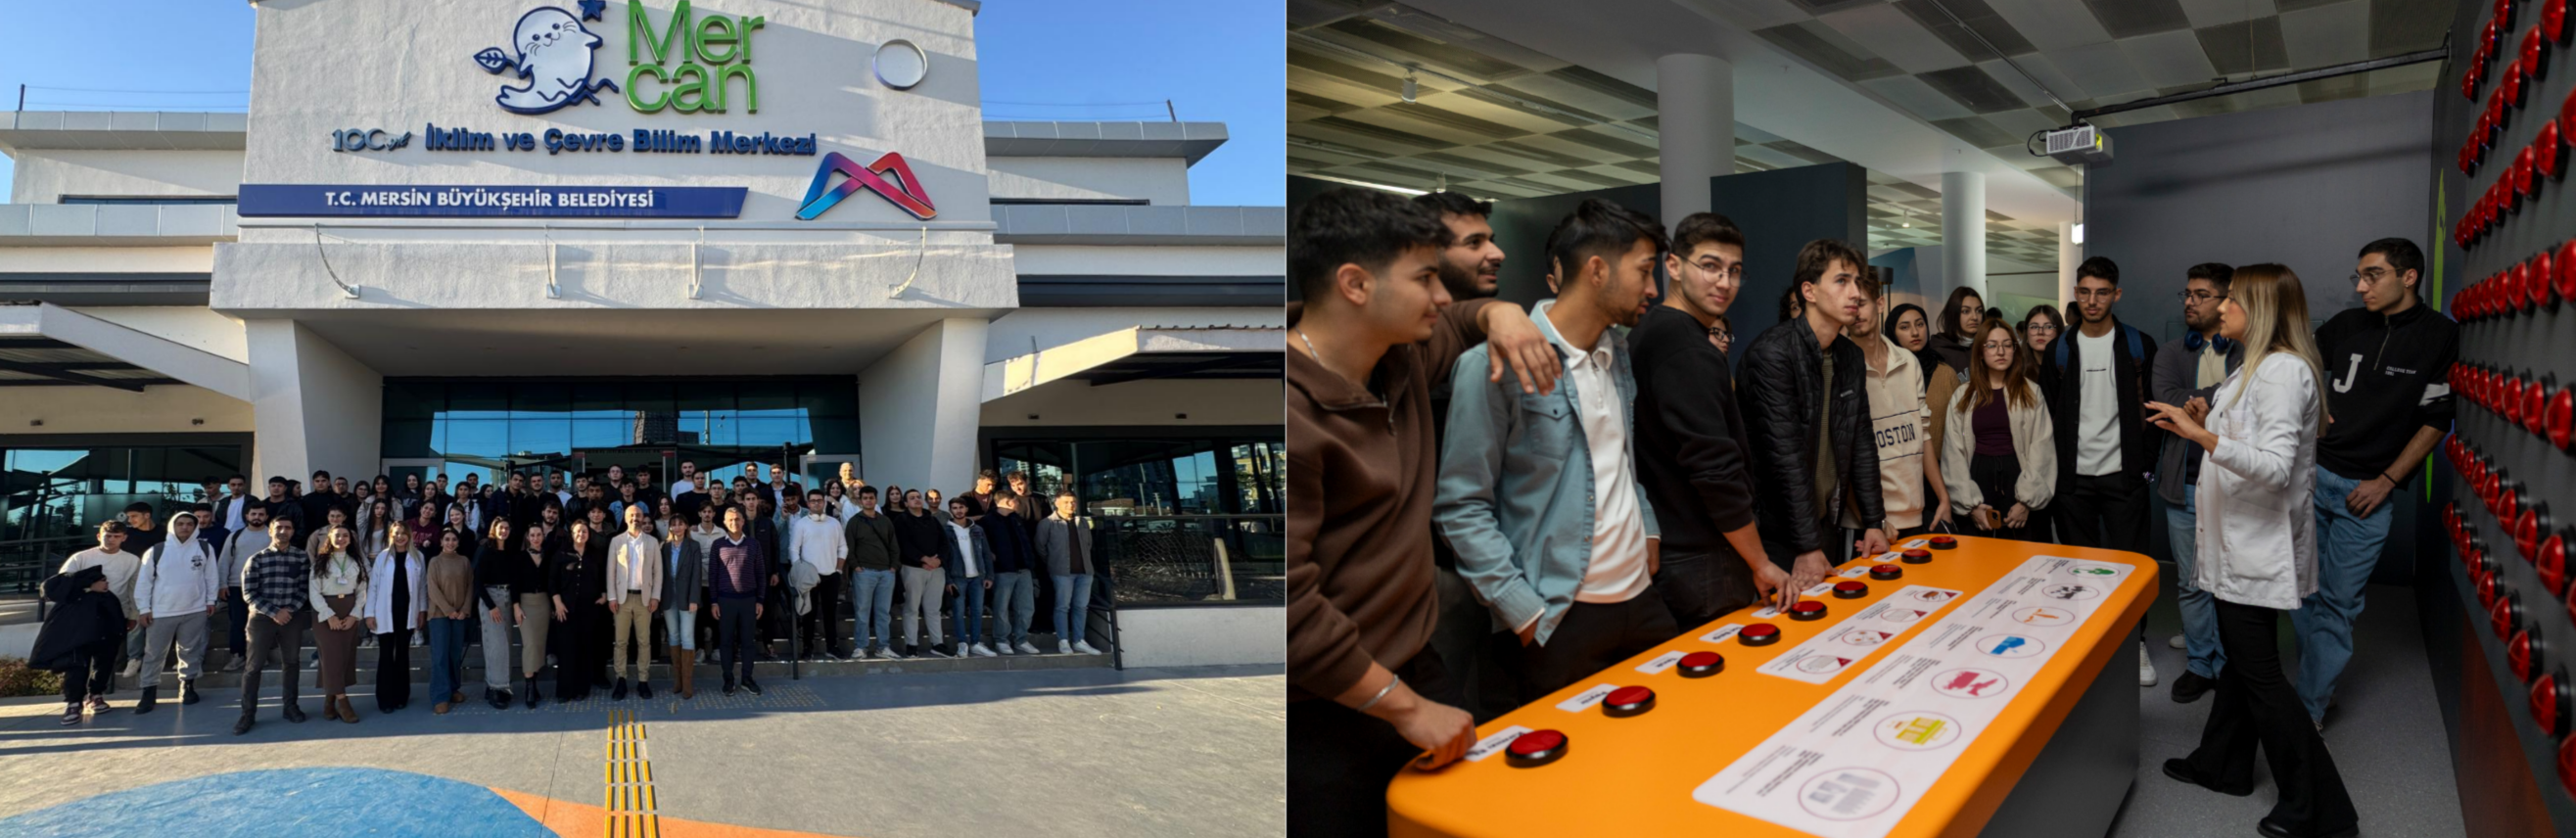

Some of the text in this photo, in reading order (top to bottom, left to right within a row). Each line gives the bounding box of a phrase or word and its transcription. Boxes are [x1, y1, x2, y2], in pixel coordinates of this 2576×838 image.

[628, 0, 765, 66] Mer
[626, 64, 758, 115] can
[425, 122, 817, 156] İklim ve Çevre Bilim Merkezi
[325, 188, 654, 211] T.C. MERSİN BÜYÜKŞEHİR BELEDİYESİ
[2332, 352, 2364, 394] J
[1875, 423, 1916, 448] OSTON
